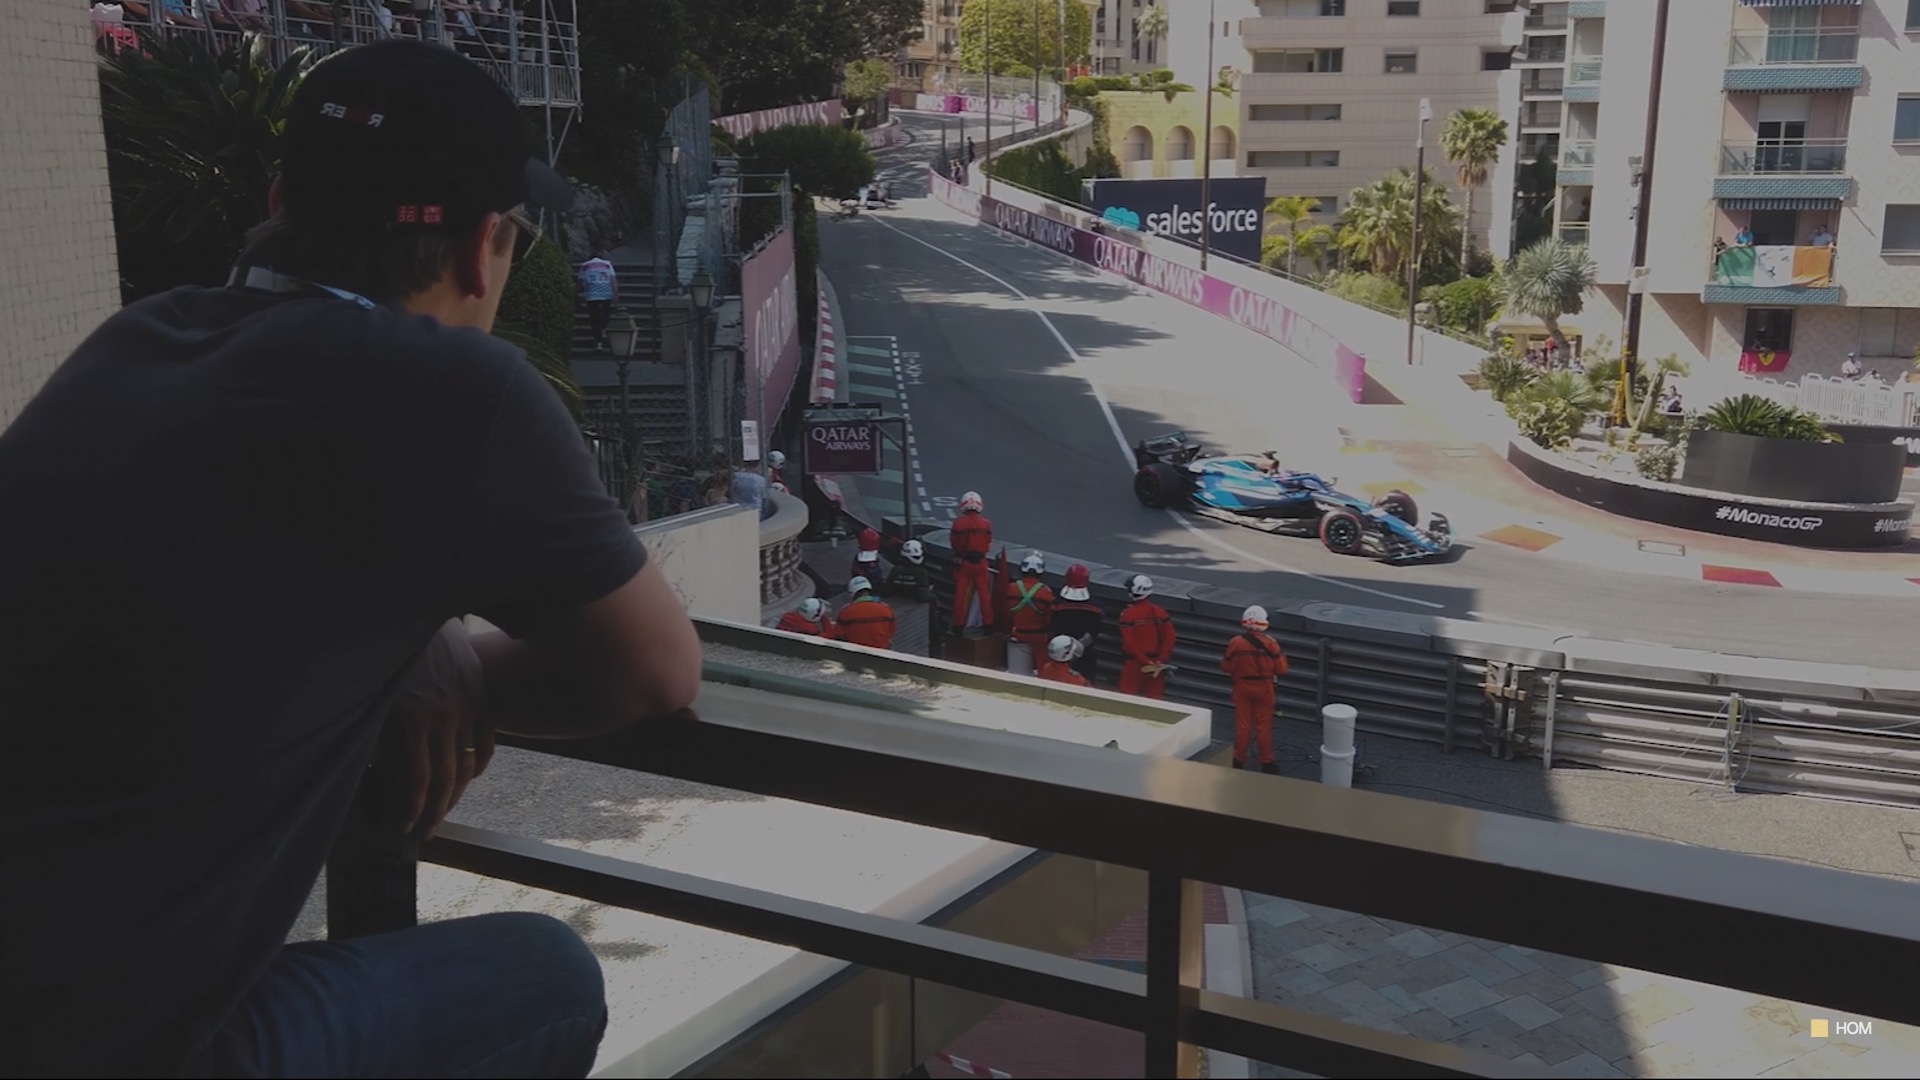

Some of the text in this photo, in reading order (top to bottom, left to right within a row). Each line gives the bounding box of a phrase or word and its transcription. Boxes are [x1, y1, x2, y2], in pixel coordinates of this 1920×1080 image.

[995, 202, 1075, 253] QATAR AIRWAYS
[1145, 202, 1258, 235] salesforce
[1093, 237, 1205, 303] QATAR AIRWAYS
[811, 426, 870, 444] QATAR
[825, 441, 871, 451] AIRWAYS
[1715, 505, 1823, 531] #MonacoGP
